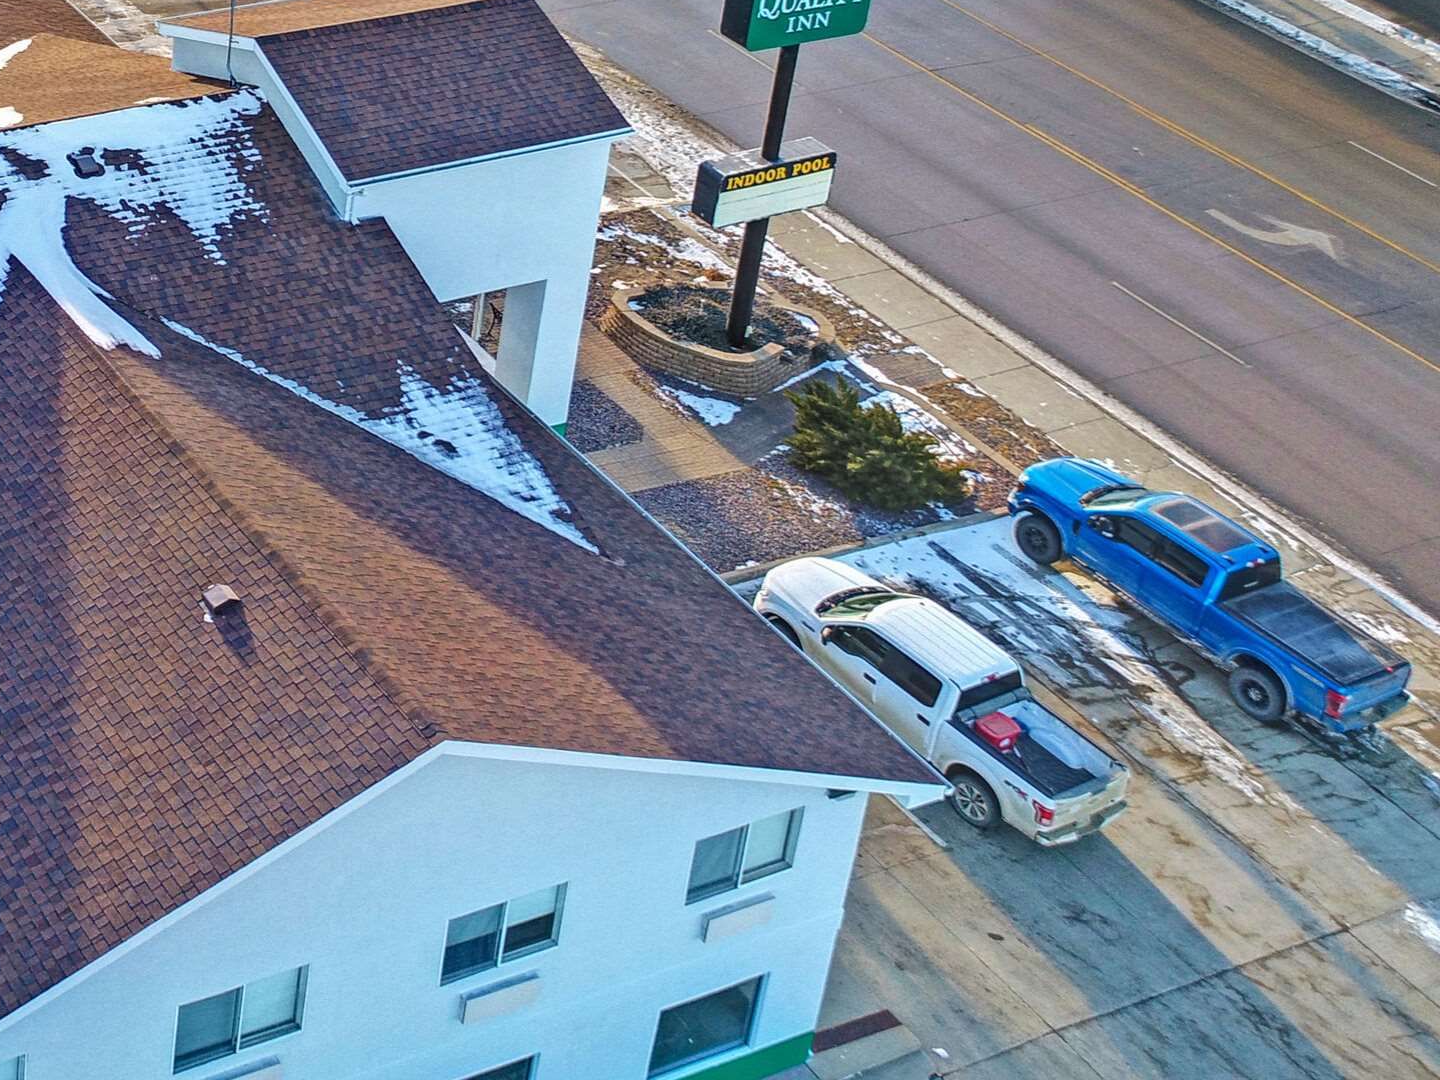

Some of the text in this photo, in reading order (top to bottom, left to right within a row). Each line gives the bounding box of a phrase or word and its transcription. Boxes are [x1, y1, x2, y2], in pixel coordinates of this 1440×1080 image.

[785, 11, 831, 33] INN
[726, 157, 831, 190] INDOOR POOL
